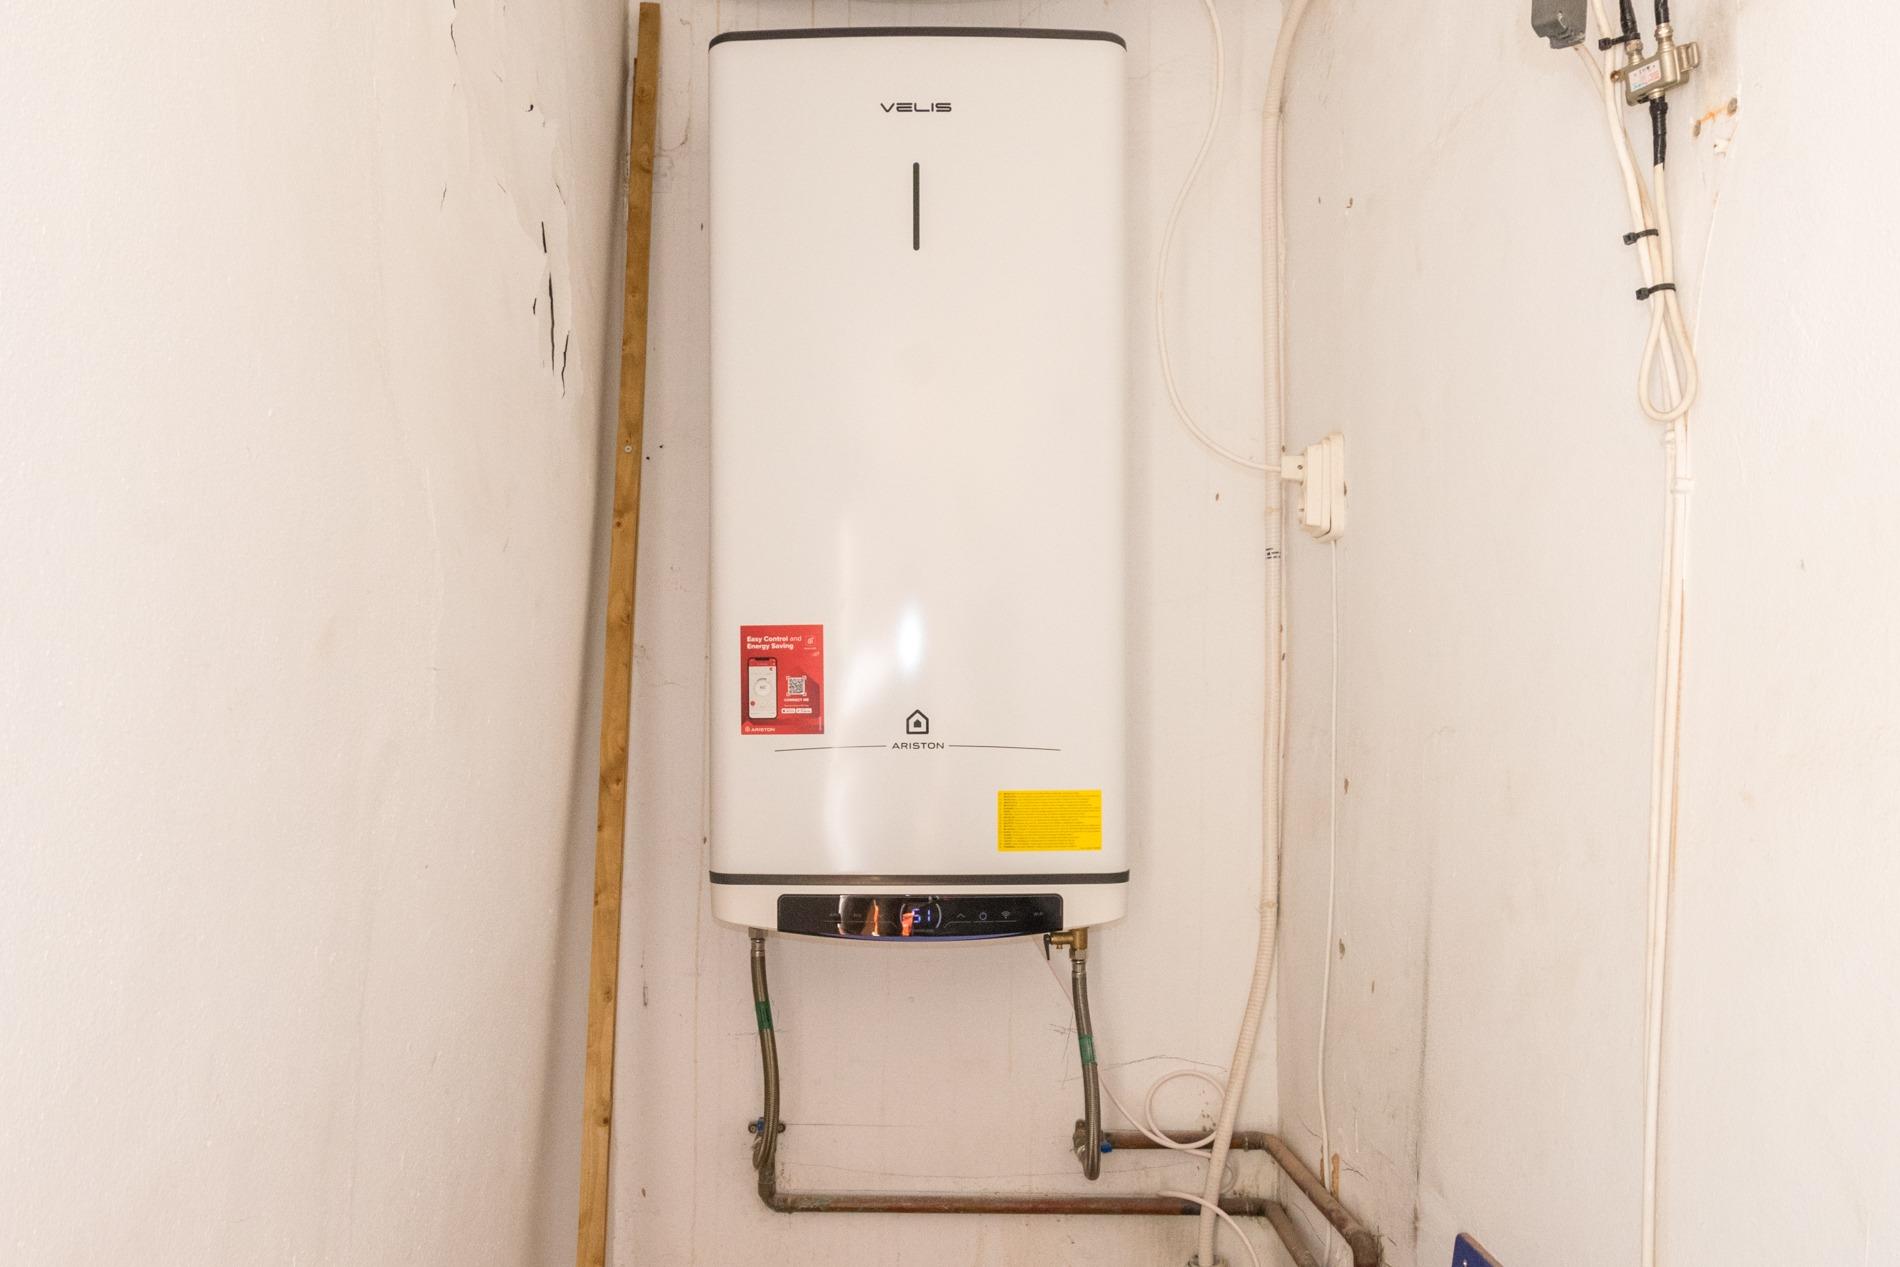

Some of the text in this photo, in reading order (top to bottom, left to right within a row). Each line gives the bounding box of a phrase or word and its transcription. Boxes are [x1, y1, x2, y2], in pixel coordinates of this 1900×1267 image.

[880, 102, 952, 113] VELIS
[746, 635, 762, 643] Easy
[891, 742, 945, 750] ARISTON
[911, 908, 931, 924] 51
